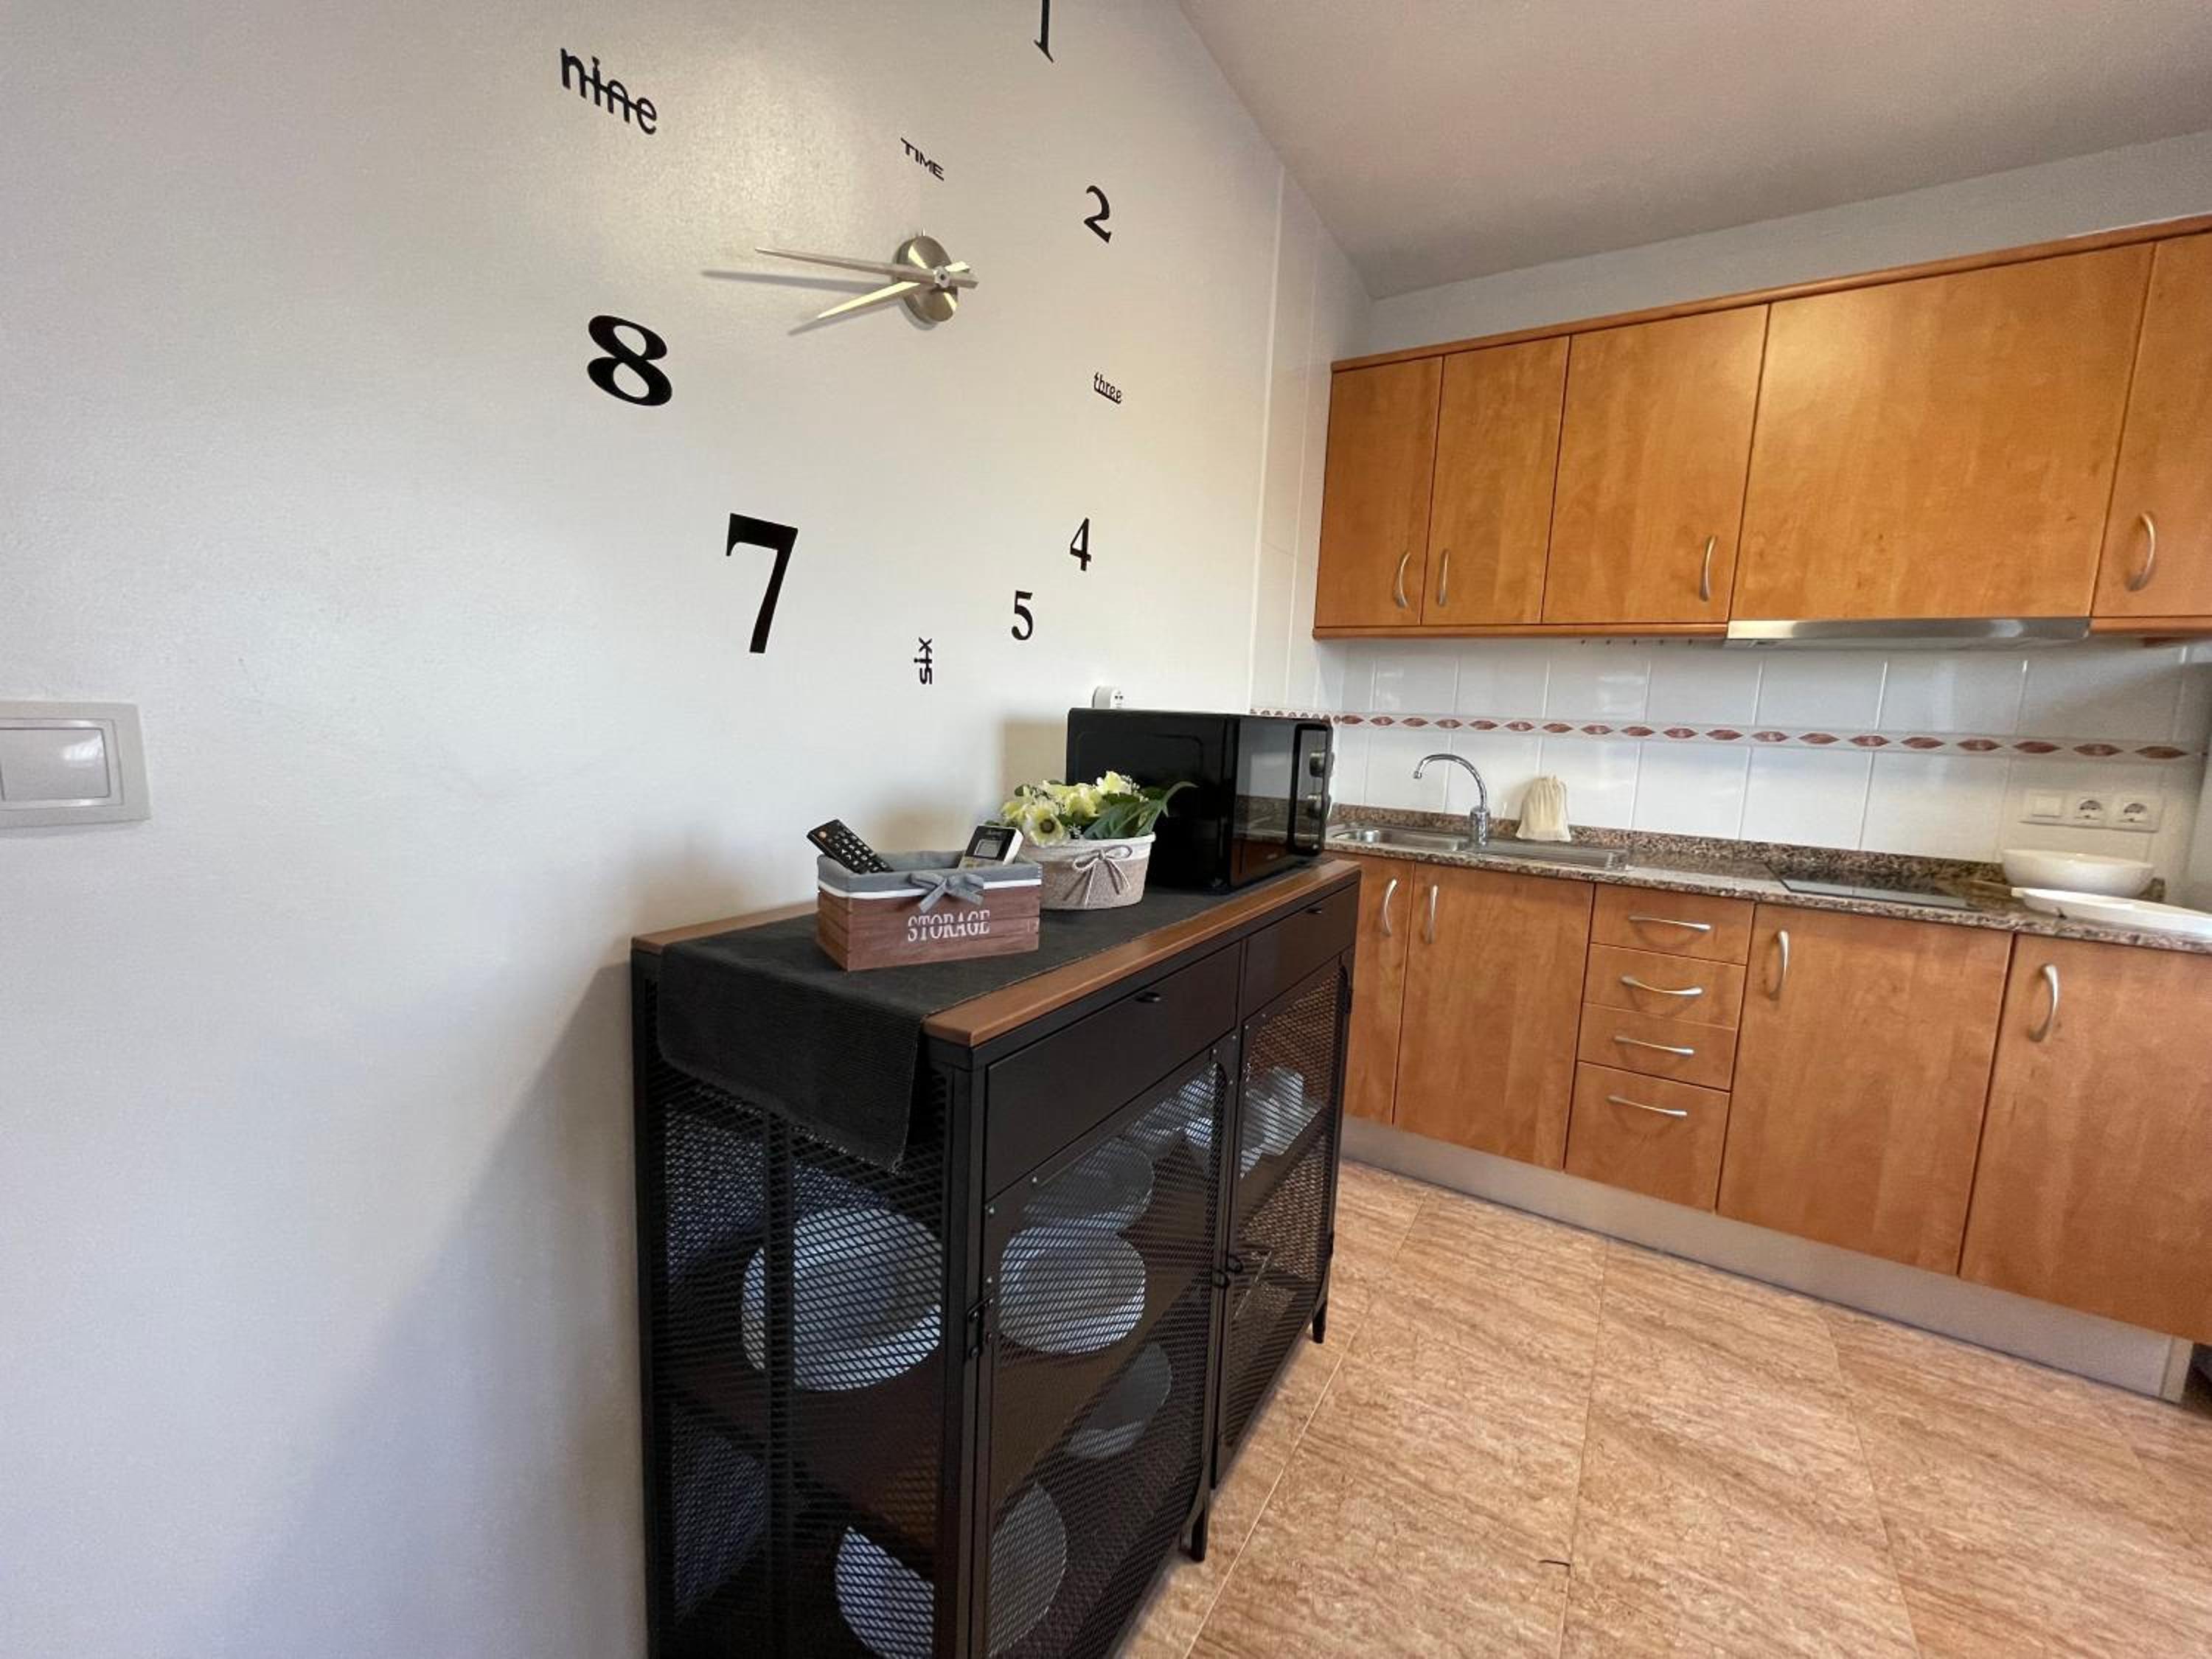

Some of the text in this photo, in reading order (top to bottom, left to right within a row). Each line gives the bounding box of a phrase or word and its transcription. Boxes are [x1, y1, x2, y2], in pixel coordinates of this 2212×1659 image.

[560, 48, 656, 135] nine
[901, 138, 945, 181] TIME
[1084, 186, 1112, 243] 2
[587, 315, 672, 406] 8
[1094, 372, 1121, 404] three
[1070, 518, 1092, 571] 4
[726, 512, 799, 654] 7
[1011, 590, 1033, 641] 5
[914, 637, 933, 684] six
[908, 909, 991, 942] STORAGE
